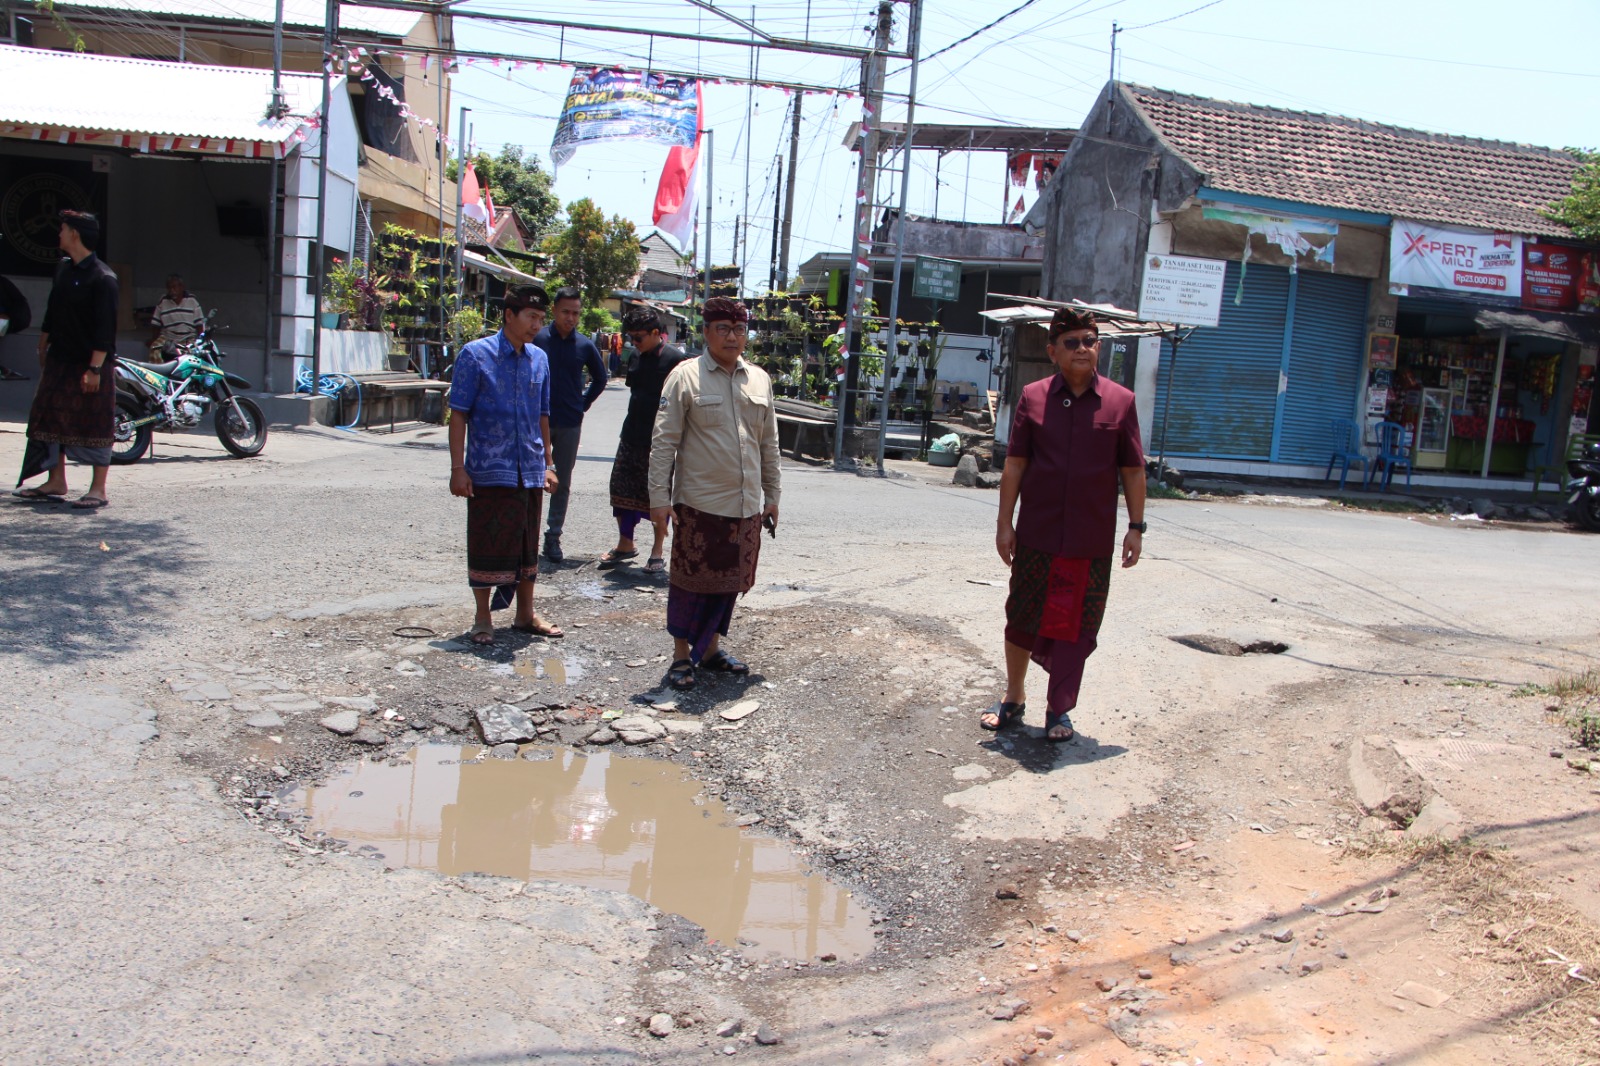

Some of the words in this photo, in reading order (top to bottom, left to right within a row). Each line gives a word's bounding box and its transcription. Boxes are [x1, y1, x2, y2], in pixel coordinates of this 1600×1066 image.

[564, 91, 616, 108] ENTAL
[1403, 231, 1478, 258] X-PERT
[1441, 256, 1474, 268] MILD
[1480, 253, 1511, 261] NIKMATIN
[1164, 259, 1186, 267] TANAH
[1148, 277, 1178, 285] SERTIFIKAT
[1112, 343, 1127, 353] KIOS
